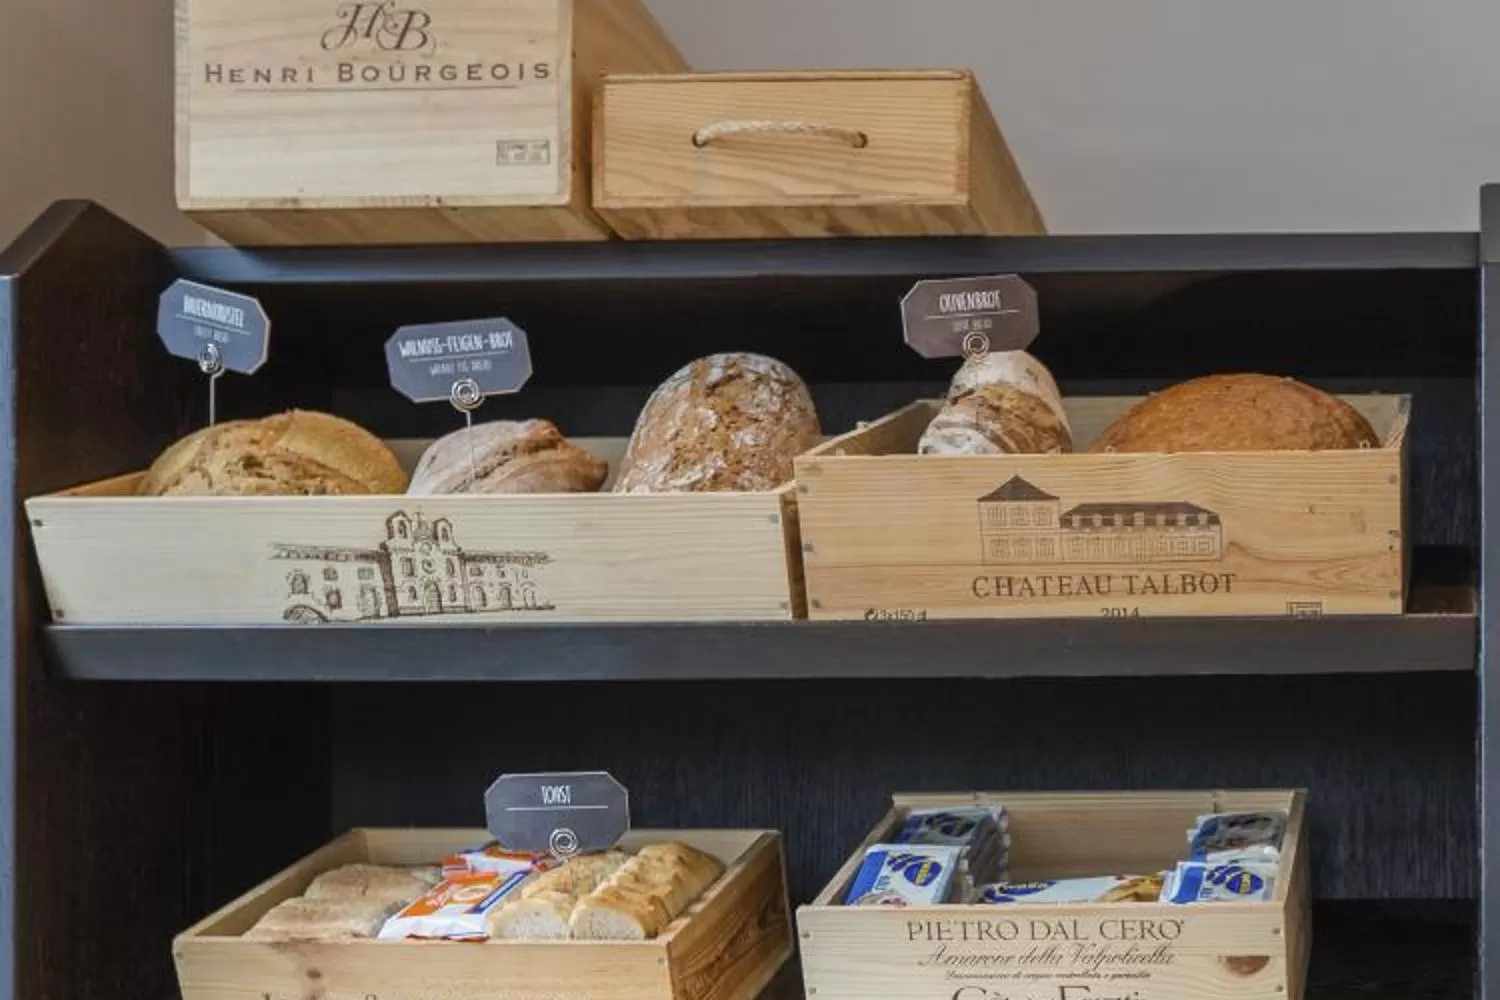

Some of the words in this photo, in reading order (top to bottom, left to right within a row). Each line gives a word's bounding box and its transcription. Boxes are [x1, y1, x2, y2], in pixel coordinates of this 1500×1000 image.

[204, 63, 313, 84] HENRI
[338, 62, 551, 83] BOURGEOIS
[972, 574, 1113, 599] CHATEAU
[1123, 573, 1239, 595] TALBOT
[540, 784, 571, 804] TOAST
[906, 919, 1019, 941] PIETRO
[1029, 919, 1089, 941] DAL
